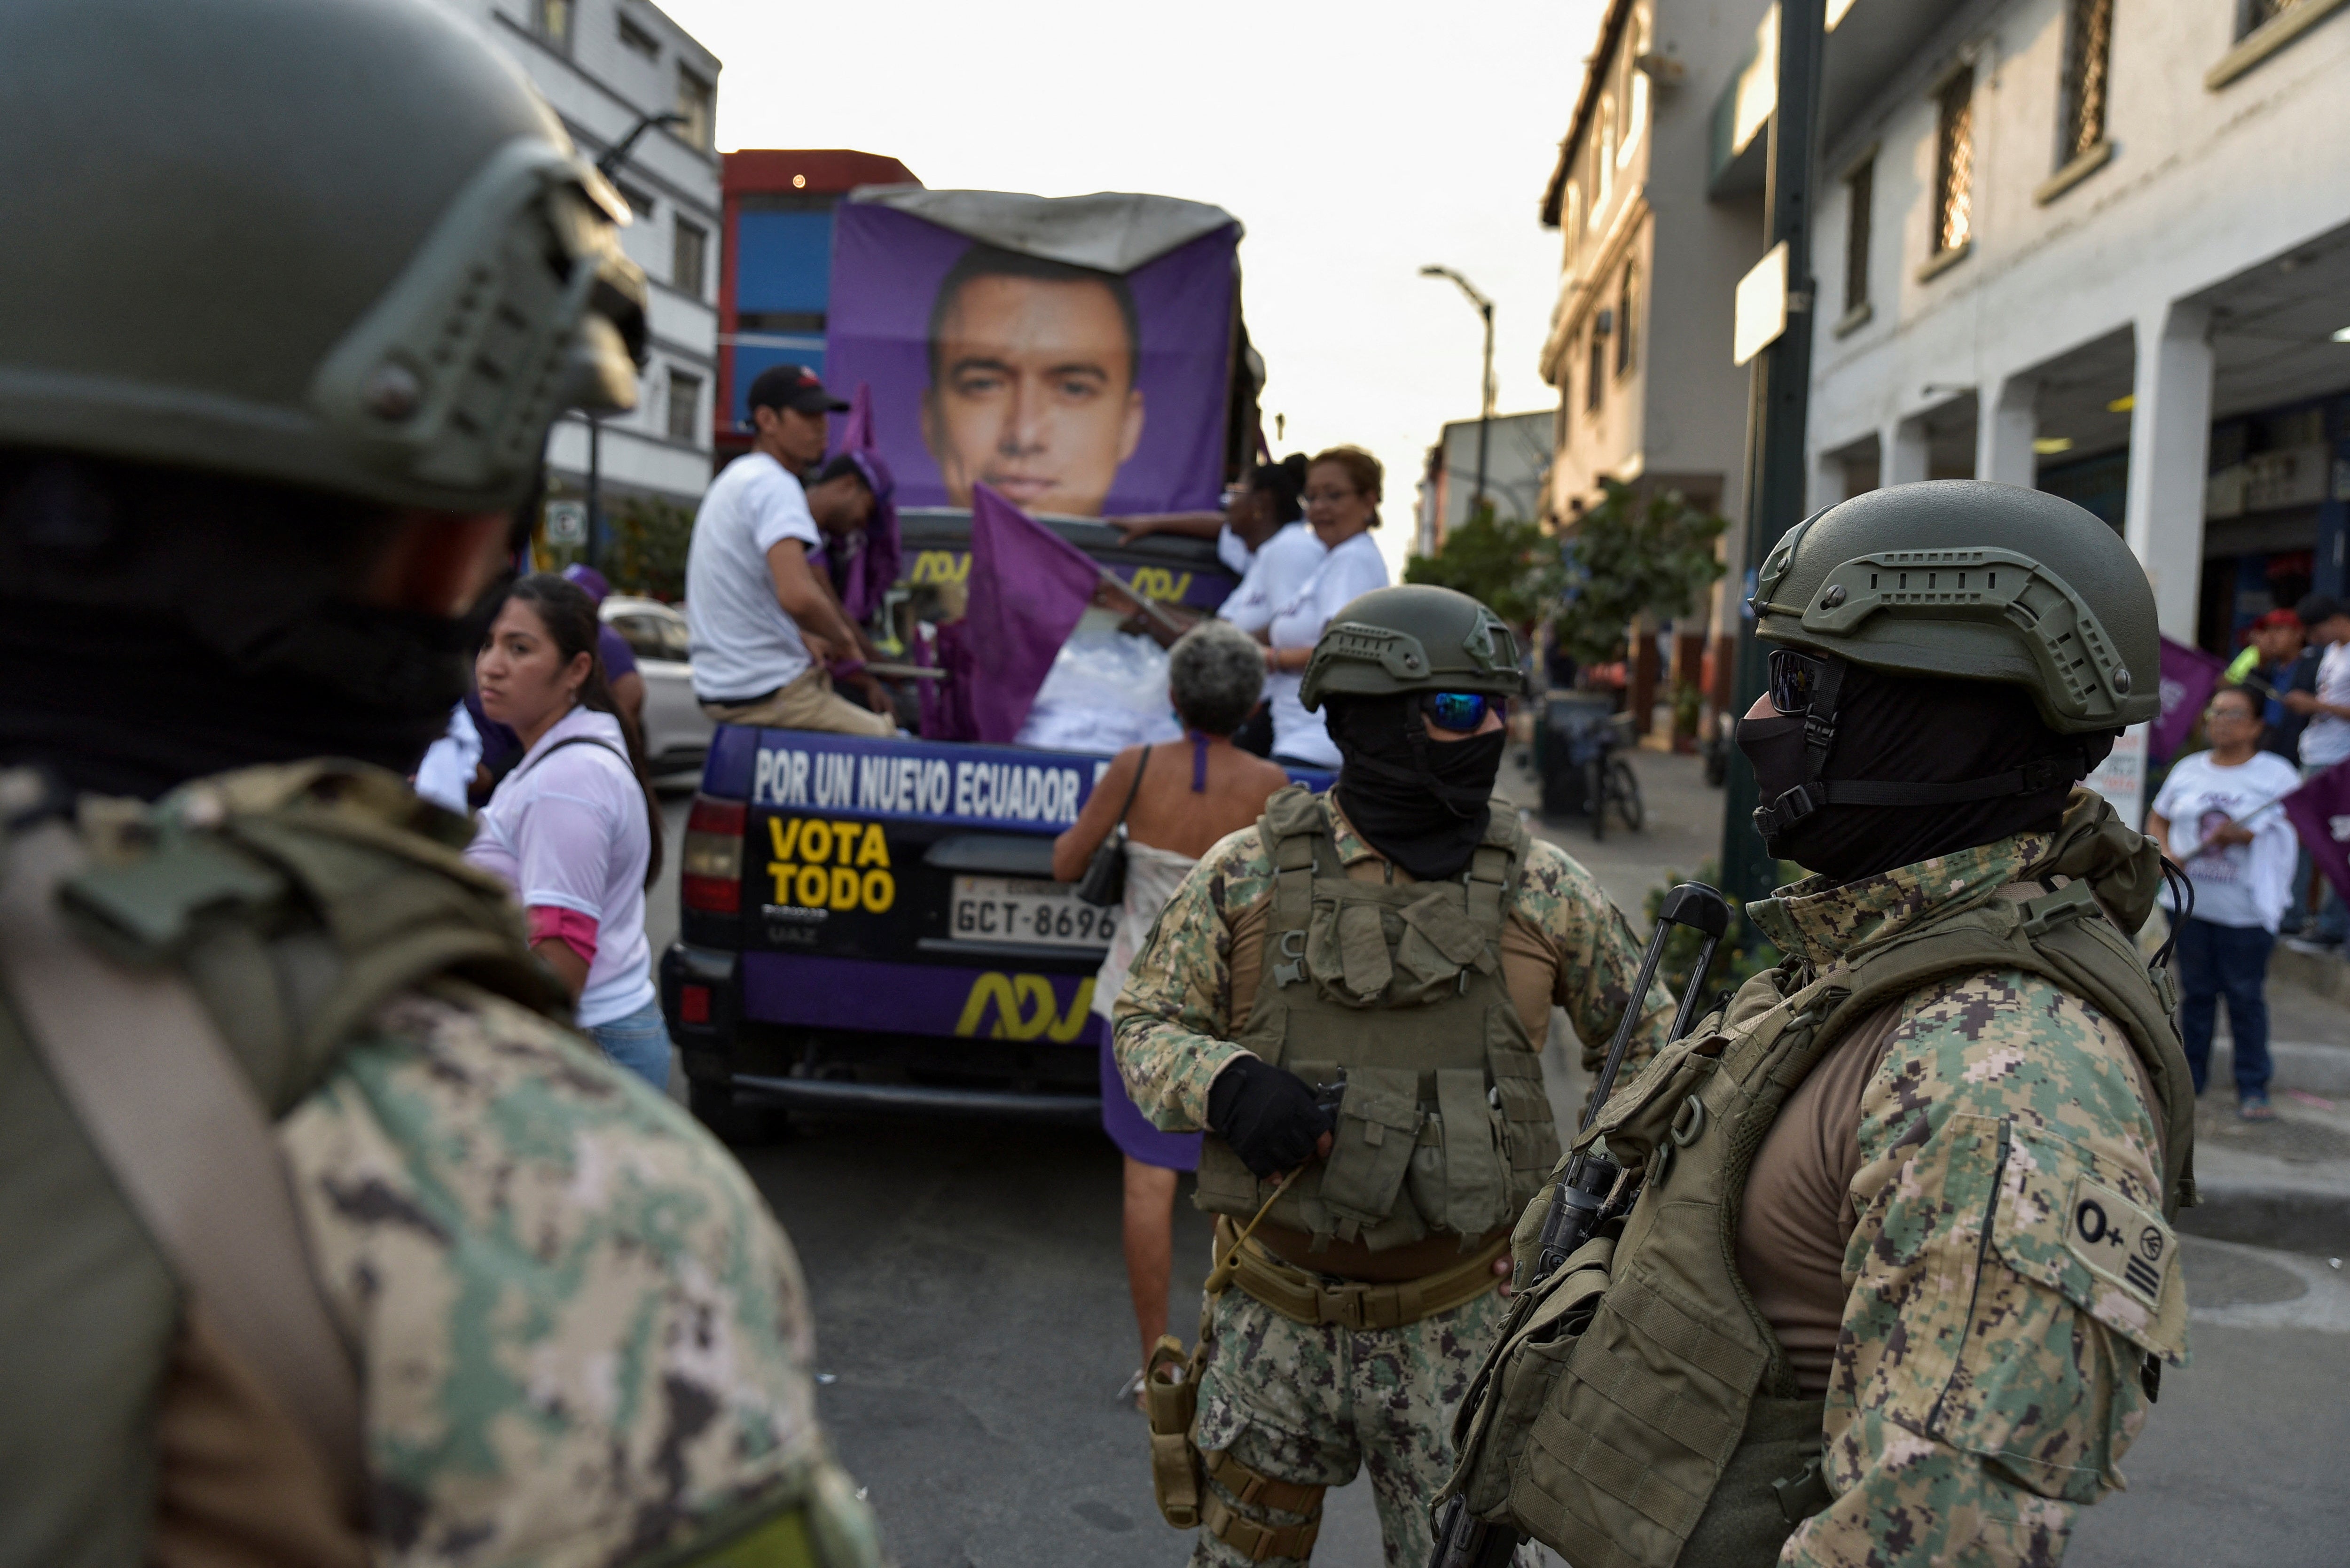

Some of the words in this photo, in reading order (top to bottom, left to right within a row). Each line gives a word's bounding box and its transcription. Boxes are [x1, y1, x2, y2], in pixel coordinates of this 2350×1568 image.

[754, 748, 810, 804] POR
[815, 753, 855, 809] UN
[859, 755, 950, 815] NUEVO
[955, 761, 1081, 824] ECUADOR
[767, 815, 892, 868] VOTA
[766, 860, 895, 914] TODO
[957, 900, 1115, 940] GCT-8696
